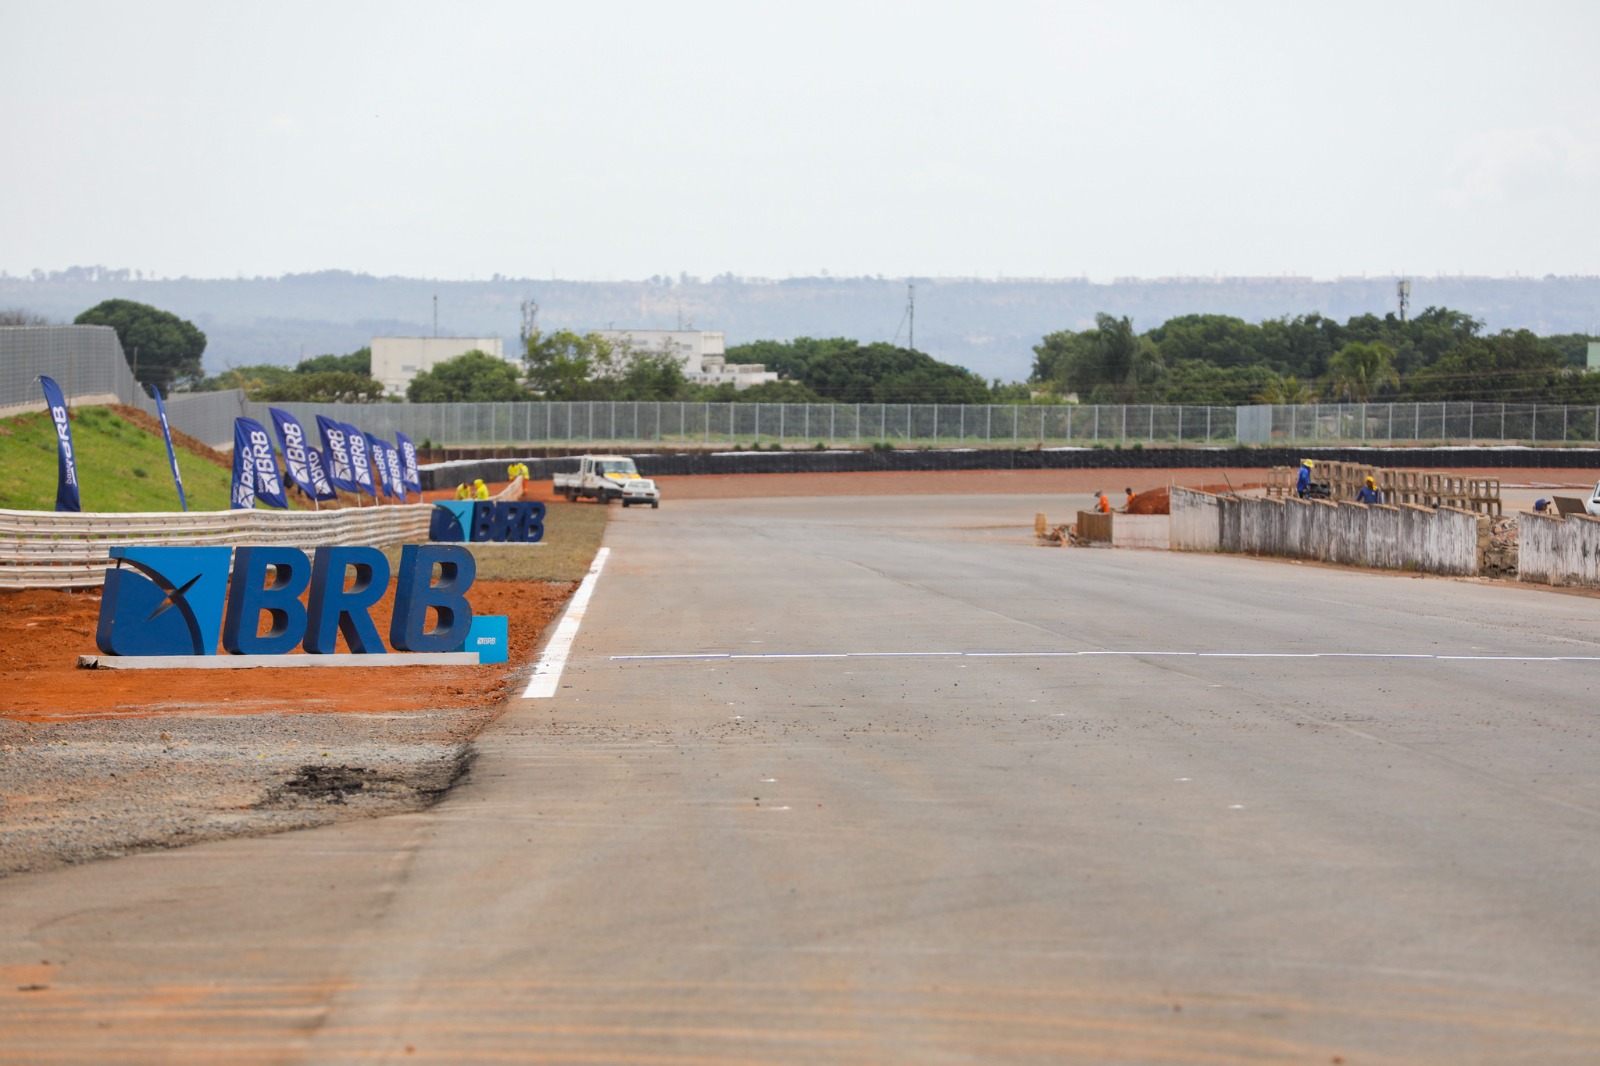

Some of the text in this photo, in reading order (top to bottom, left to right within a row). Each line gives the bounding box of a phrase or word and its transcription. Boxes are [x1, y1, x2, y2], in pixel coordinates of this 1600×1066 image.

[251, 431, 274, 473] BRB
[283, 422, 305, 462] BRB
[327, 428, 348, 463] BRB
[349, 434, 367, 468] BRB
[403, 441, 416, 469] BRB
[386, 449, 400, 478] BRB
[470, 501, 546, 542] BRB
[223, 545, 476, 655] BRB
